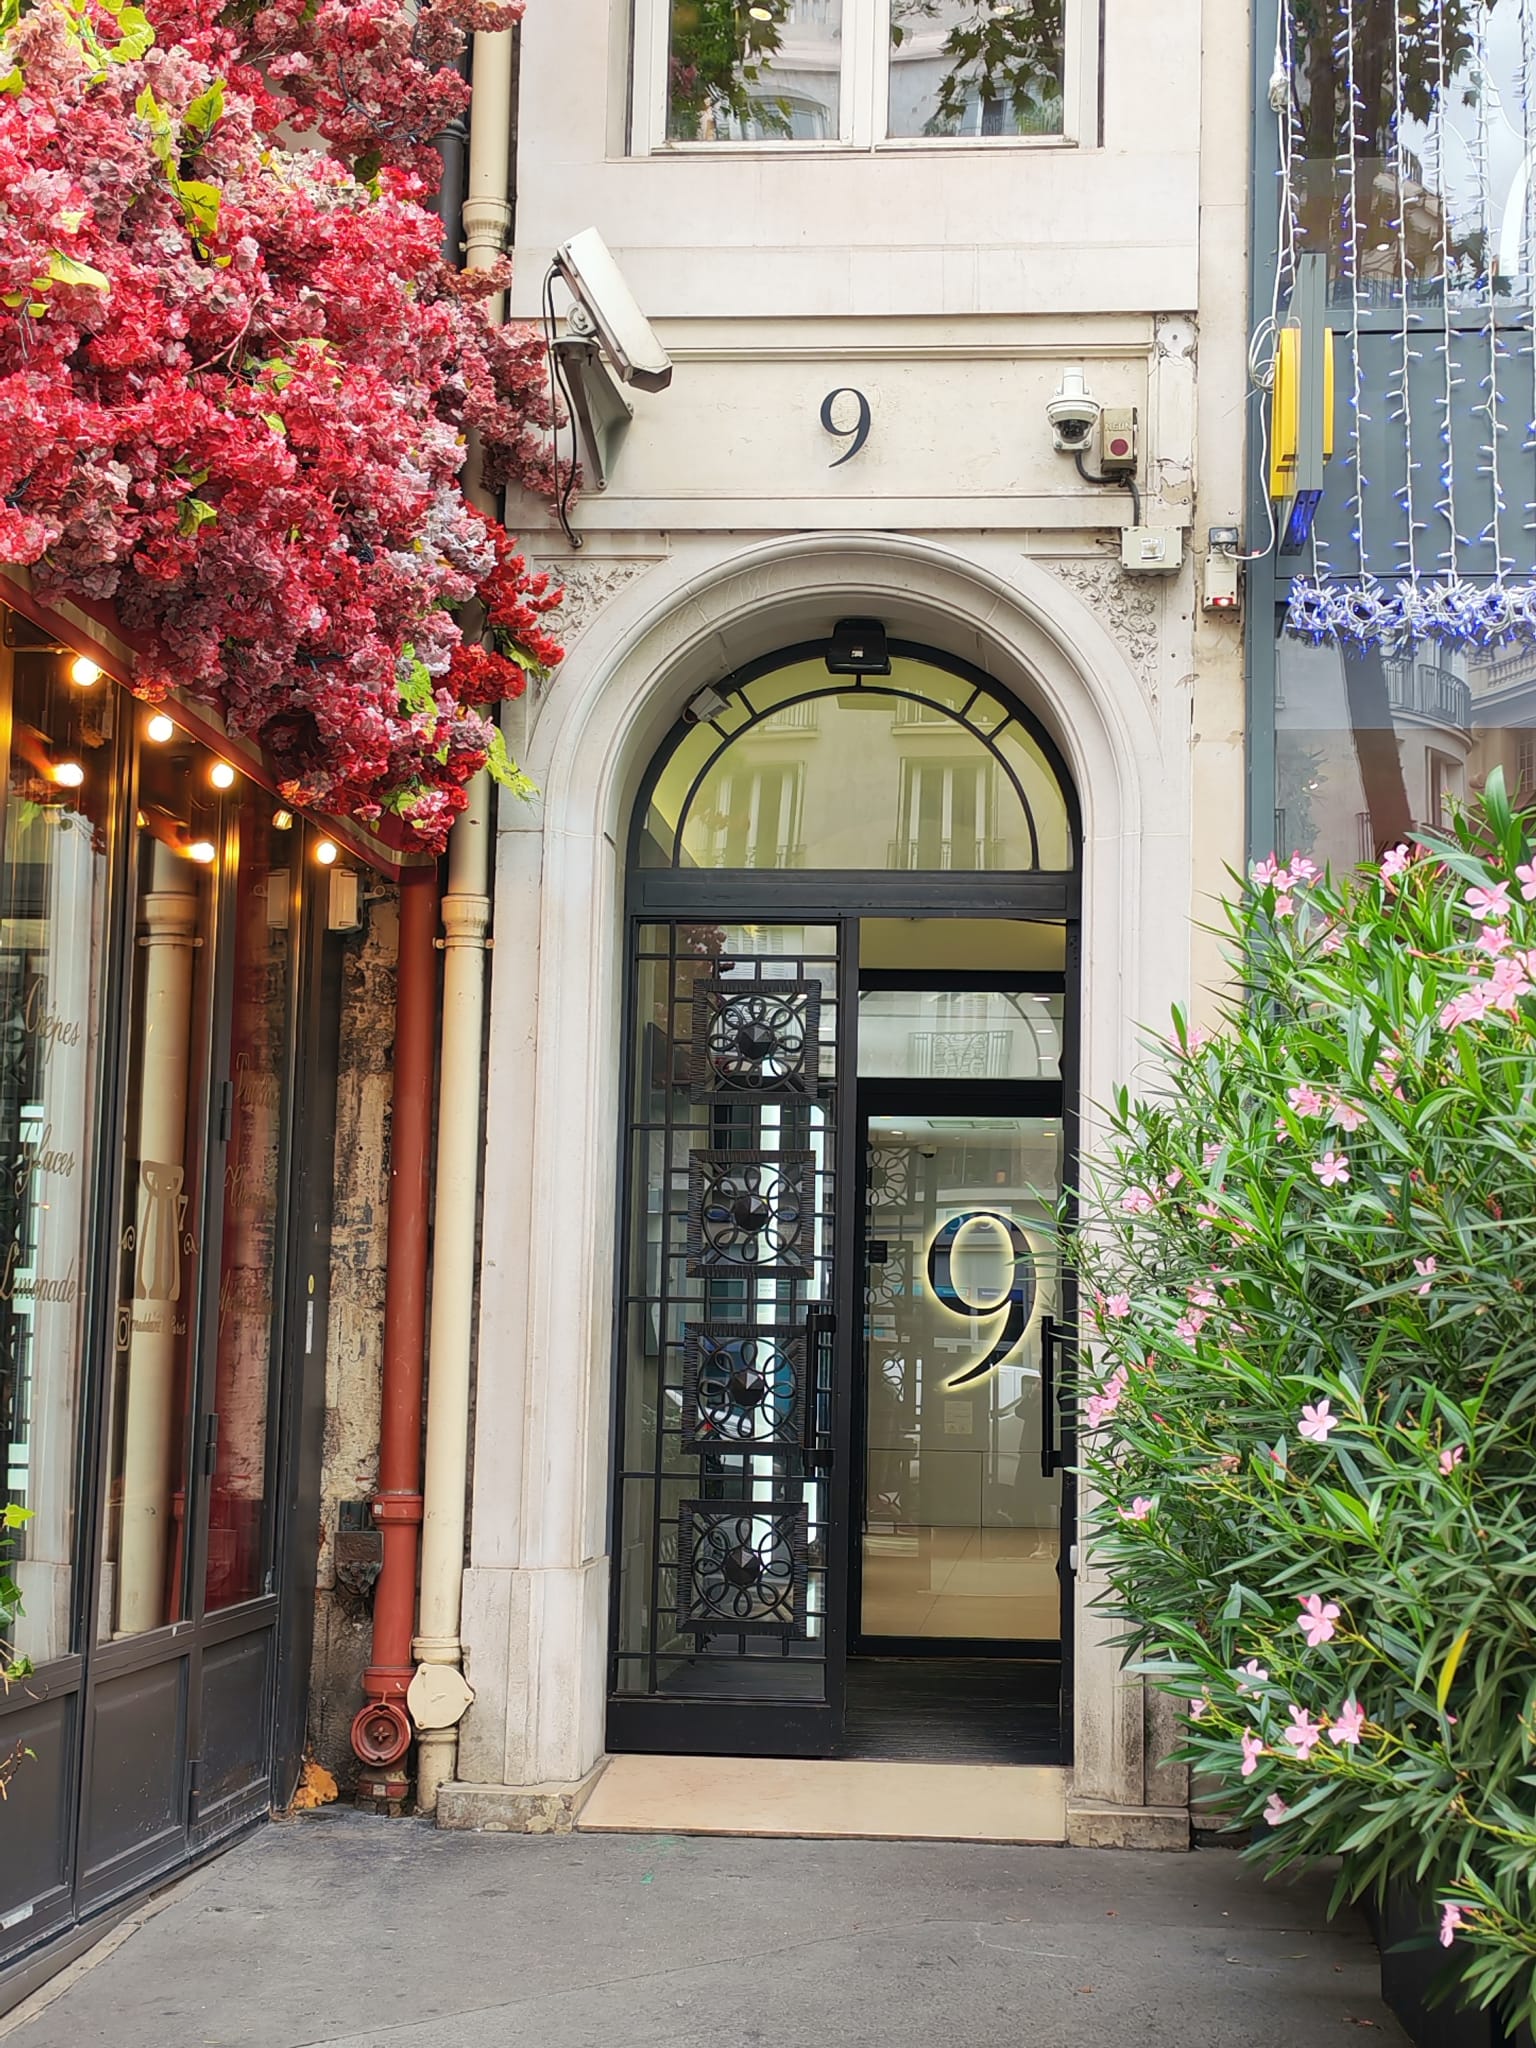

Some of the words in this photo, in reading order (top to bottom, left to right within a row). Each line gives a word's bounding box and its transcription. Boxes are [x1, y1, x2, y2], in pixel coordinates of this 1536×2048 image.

[820, 387, 872, 469] 9
[0, 1240, 77, 1303] Limonade
[927, 1211, 1037, 1388] 9
